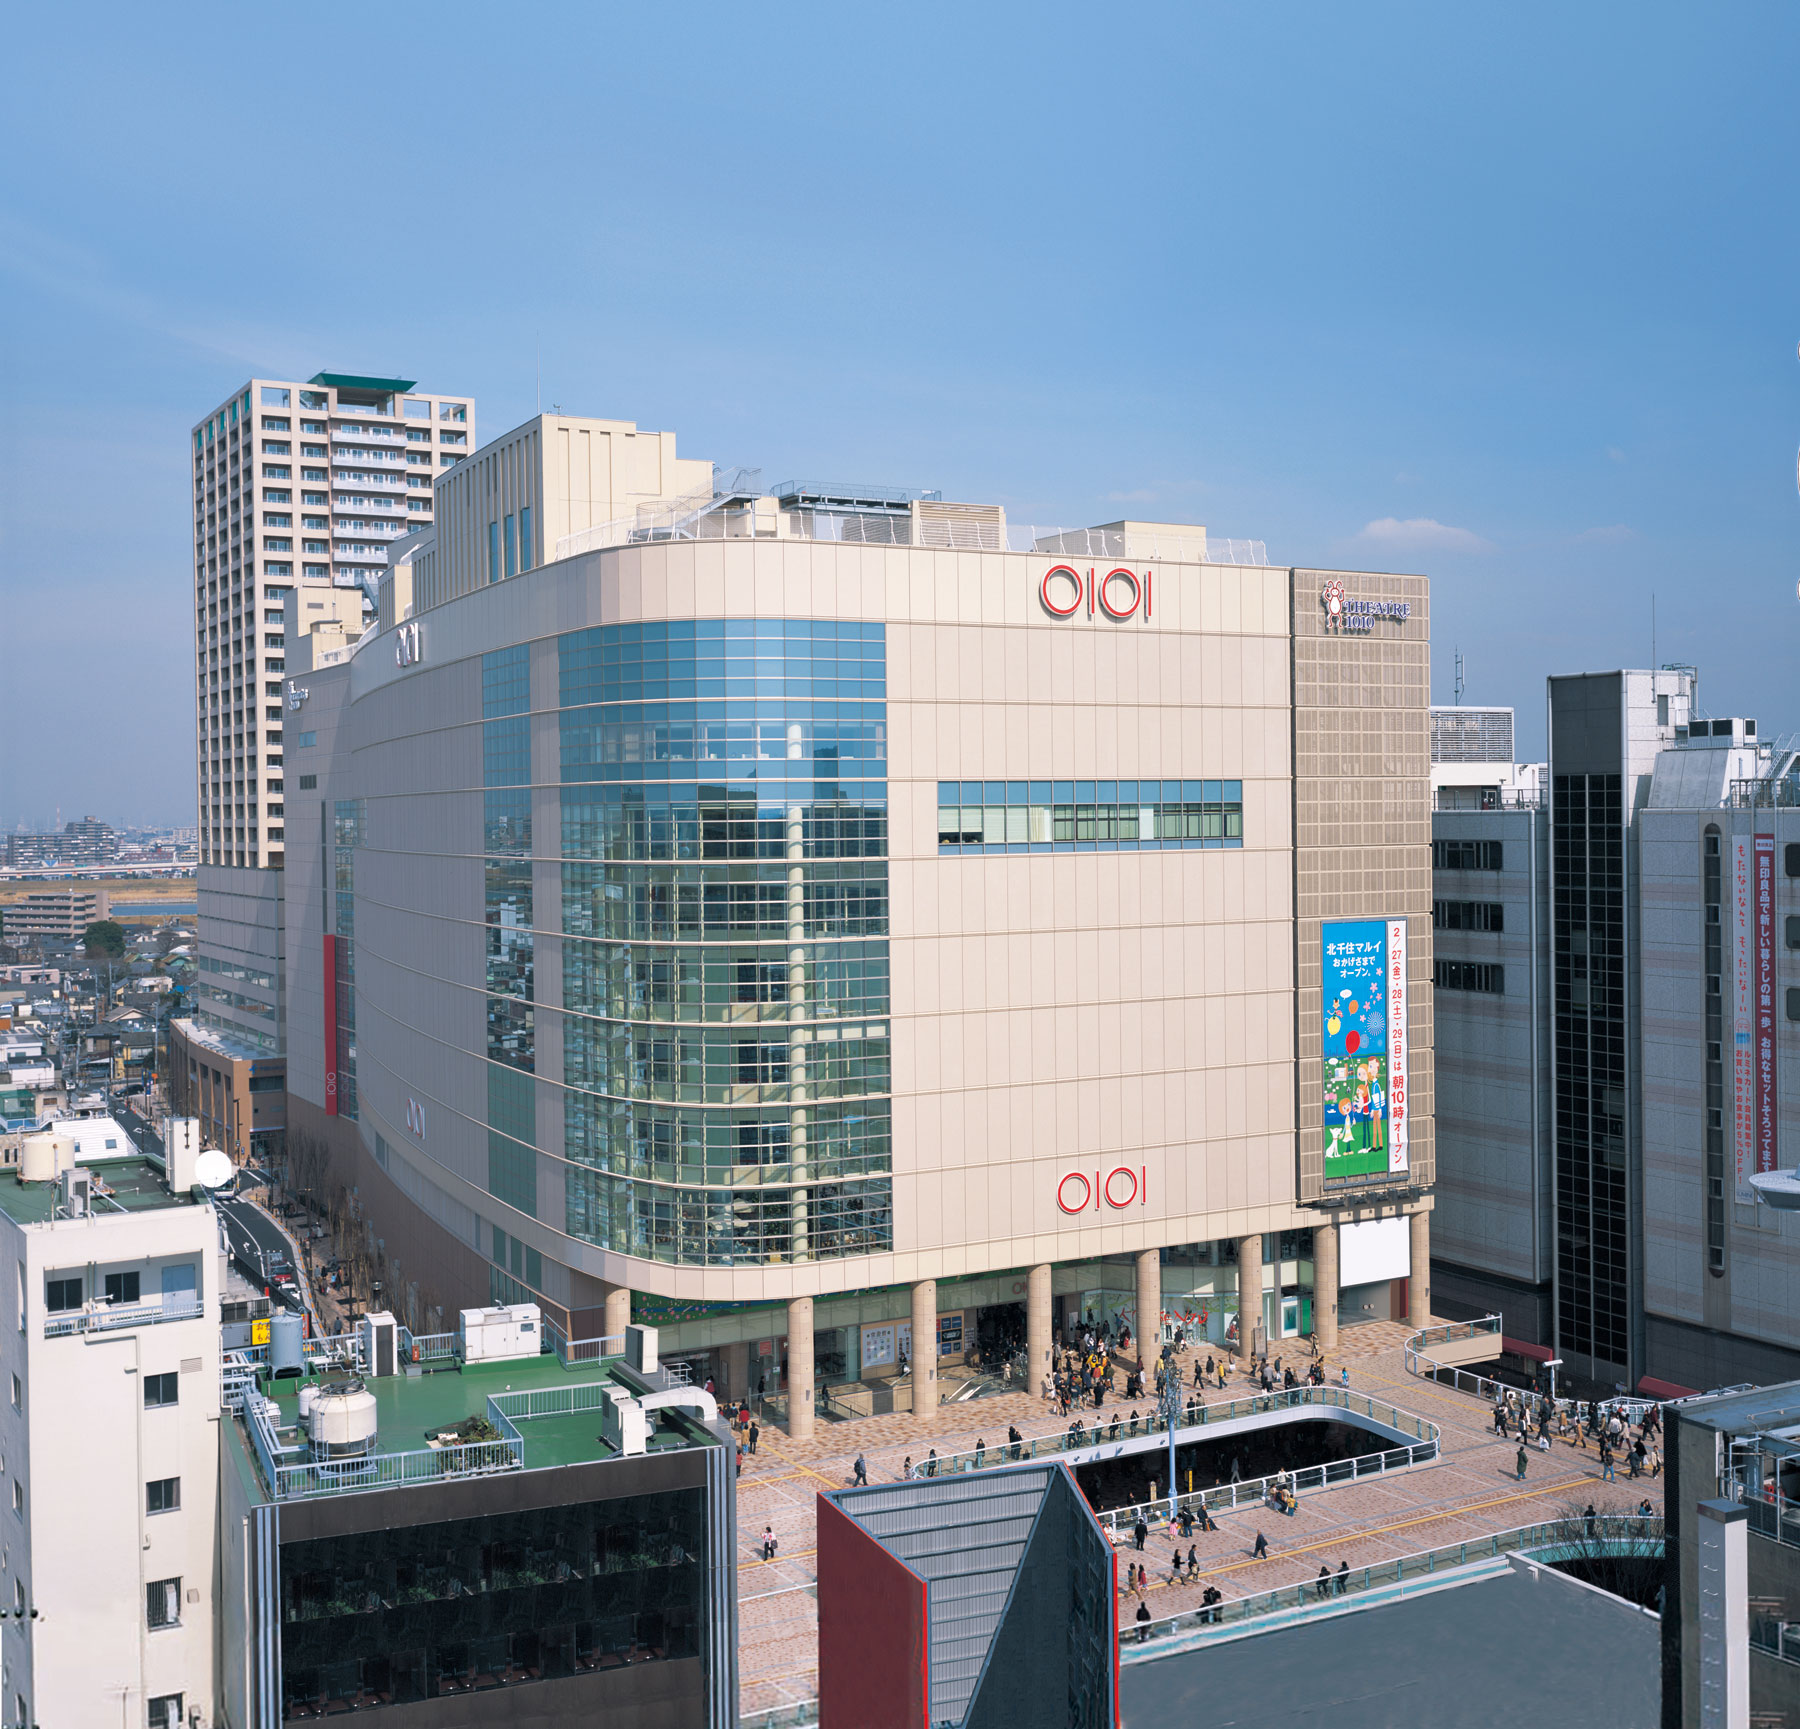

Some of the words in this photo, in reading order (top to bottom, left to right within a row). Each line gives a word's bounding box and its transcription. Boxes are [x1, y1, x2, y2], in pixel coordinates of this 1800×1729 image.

[1343, 598, 1411, 619] THEATRE
[1345, 615, 1375, 629] 1010
[1326, 940, 1382, 956] 北千住マルイ
[1332, 956, 1376, 968] おかげさまで
